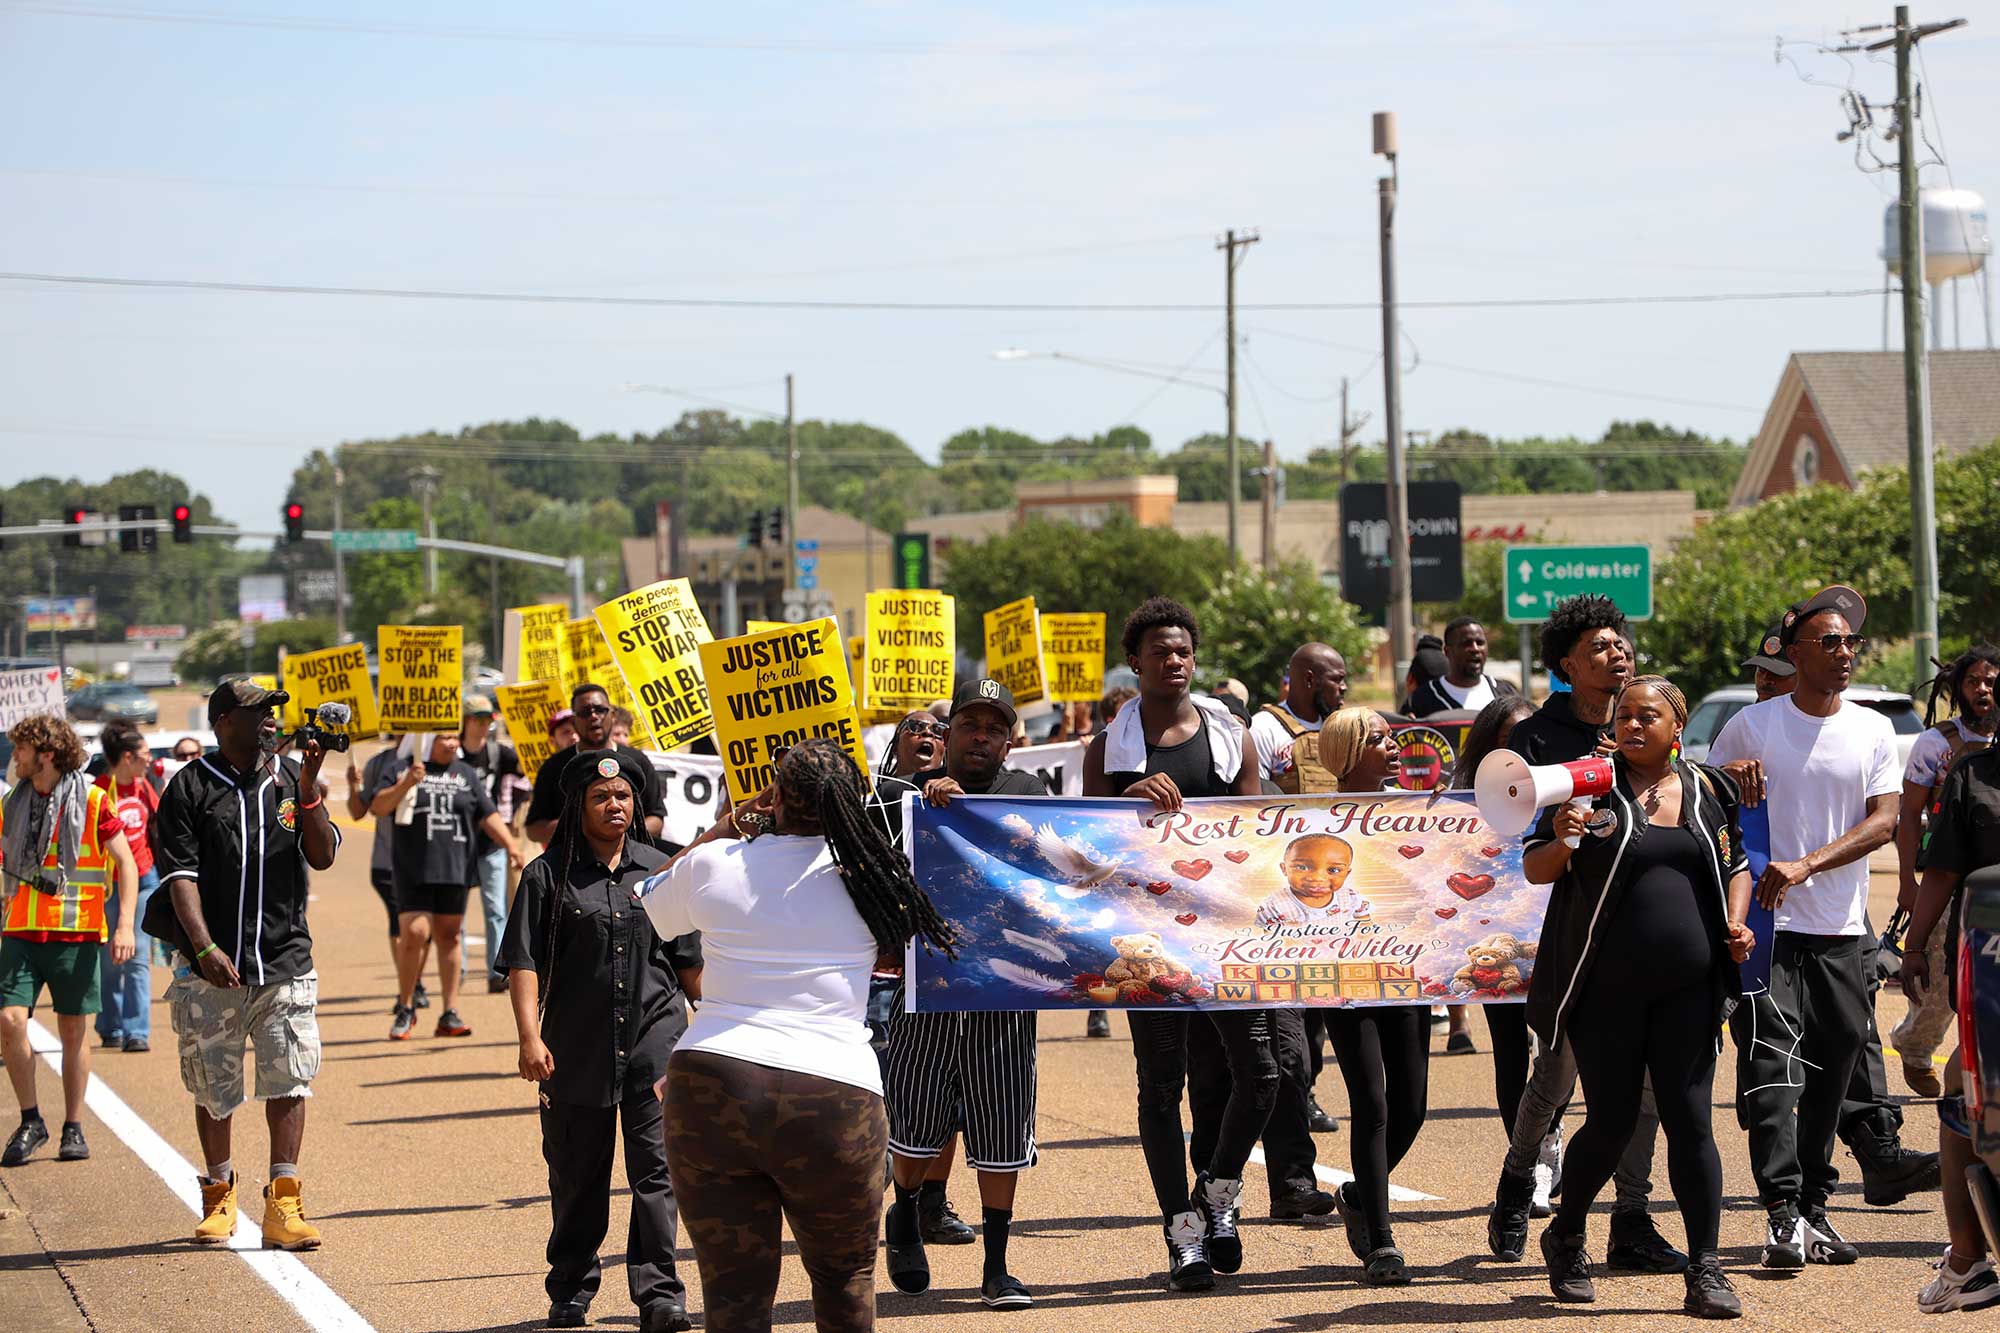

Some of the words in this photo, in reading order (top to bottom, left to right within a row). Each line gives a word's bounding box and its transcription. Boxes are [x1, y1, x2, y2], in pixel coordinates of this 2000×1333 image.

[1541, 560, 1641, 580] Coldwater
[618, 595, 644, 612] The
[646, 584, 680, 604] people
[880, 600, 942, 616] JUSTICE
[617, 615, 671, 653] STOP
[674, 608, 702, 630] THE
[878, 629, 944, 648] VICTIMS
[384, 647, 423, 663] STOP
[430, 648, 456, 663] THE
[650, 631, 699, 663] WAR
[722, 629, 824, 673] JUSTICE
[1043, 638, 1102, 654] RELEASE
[298, 650, 365, 680] JUSTICE
[402, 664, 439, 678] WAR
[756, 668, 778, 689] for
[782, 660, 802, 678] all
[872, 657, 889, 674] OF
[896, 658, 949, 676] POLICE
[1057, 663, 1085, 679] THE
[0, 673, 42, 689] OHEN
[317, 673, 351, 695] FOR
[640, 675, 676, 707] ON
[873, 677, 947, 695] VIOLENCE
[383, 685, 405, 701] ON
[409, 686, 458, 702] BLACK
[727, 675, 838, 721] VICTIMS
[381, 703, 459, 718] AMERICA!
[506, 704, 535, 722] STOP
[540, 700, 562, 718] THE
[650, 687, 709, 732] AMER
[524, 719, 548, 735] WA
[518, 742, 537, 758] ON
[728, 737, 758, 766] OF
[1146, 811, 1243, 846] Rest
[1255, 804, 1309, 837] In
[1325, 802, 1482, 837] Heaven
[1261, 921, 1341, 942] Justice
[1343, 919, 1384, 937] For
[1213, 937, 1321, 964] Kohen
[1328, 935, 1429, 965] Wiley
[1231, 965, 1407, 980] KOHEN
[1222, 984, 1413, 999] WILEY
